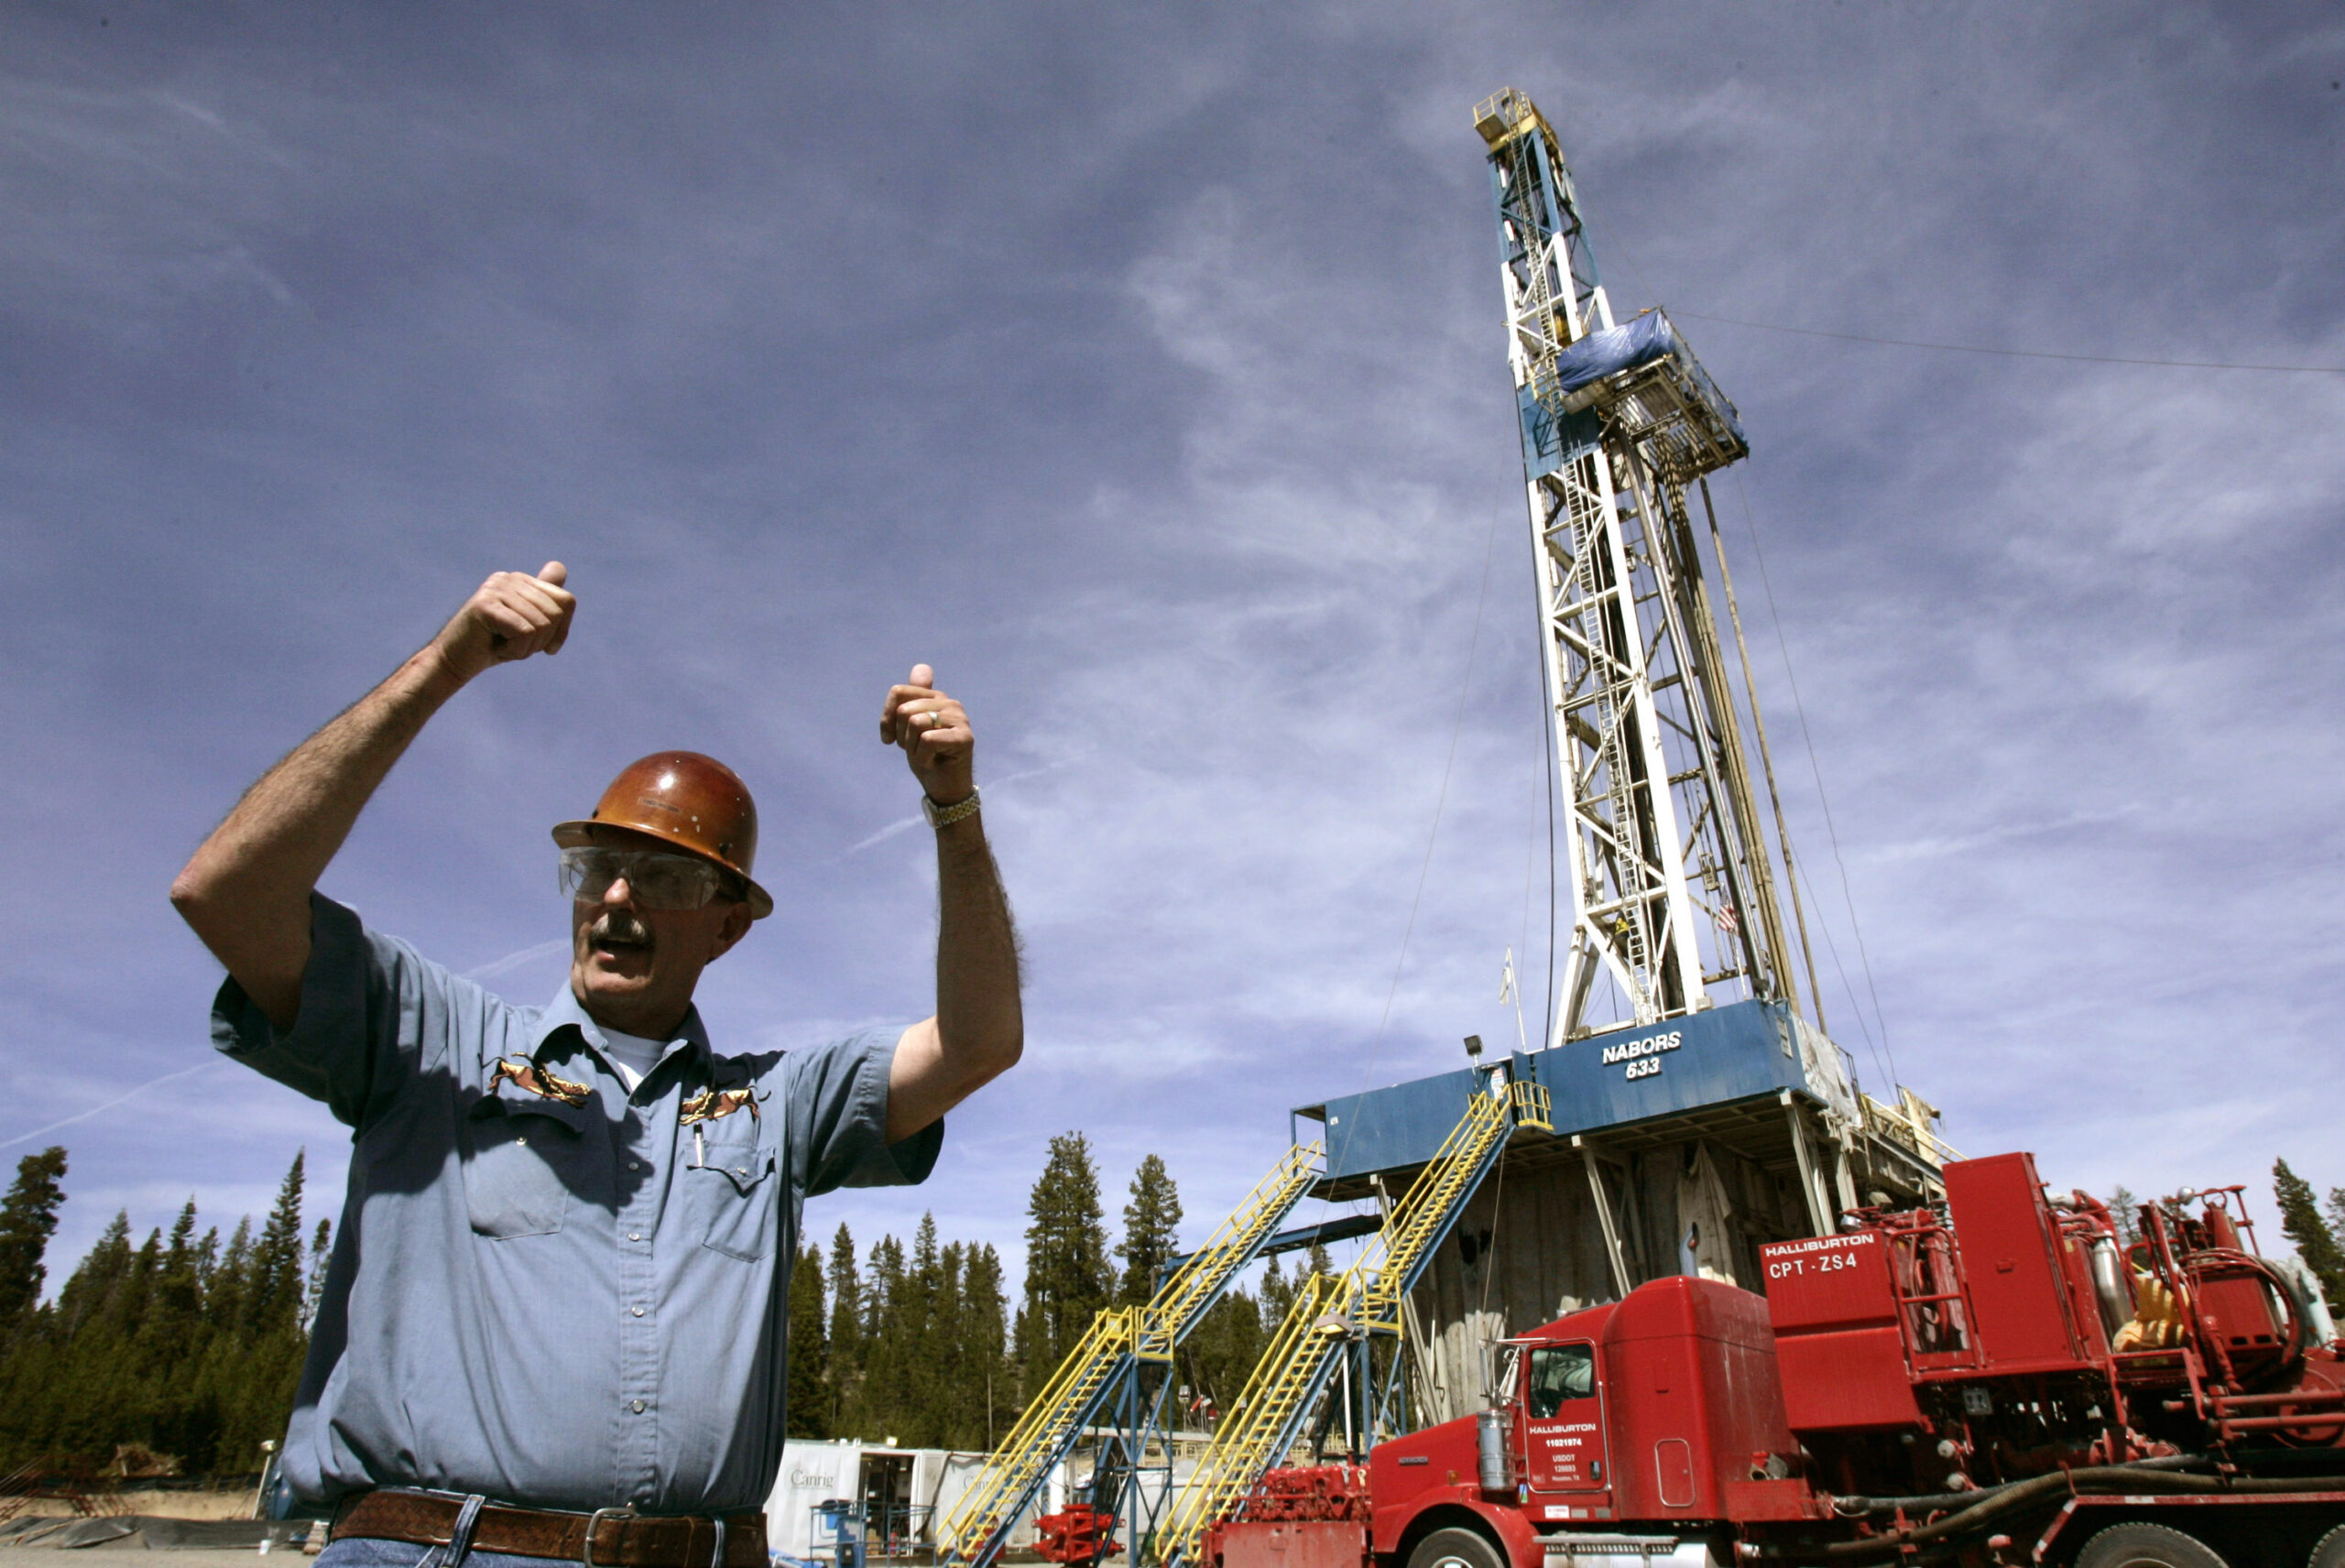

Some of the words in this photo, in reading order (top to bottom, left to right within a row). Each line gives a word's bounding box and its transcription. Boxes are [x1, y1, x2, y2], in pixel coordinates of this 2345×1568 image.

[1602, 1031, 1682, 1064] NABORS
[1626, 1057, 1661, 1079] 633
[1765, 1234, 1875, 1258] HALLIBURTON
[1769, 1259, 1804, 1279] CPT
[1529, 1422, 1597, 1434] HALLIBURTON
[1552, 1454, 1576, 1463] USDOT
[791, 1468, 834, 1488] Canrig
